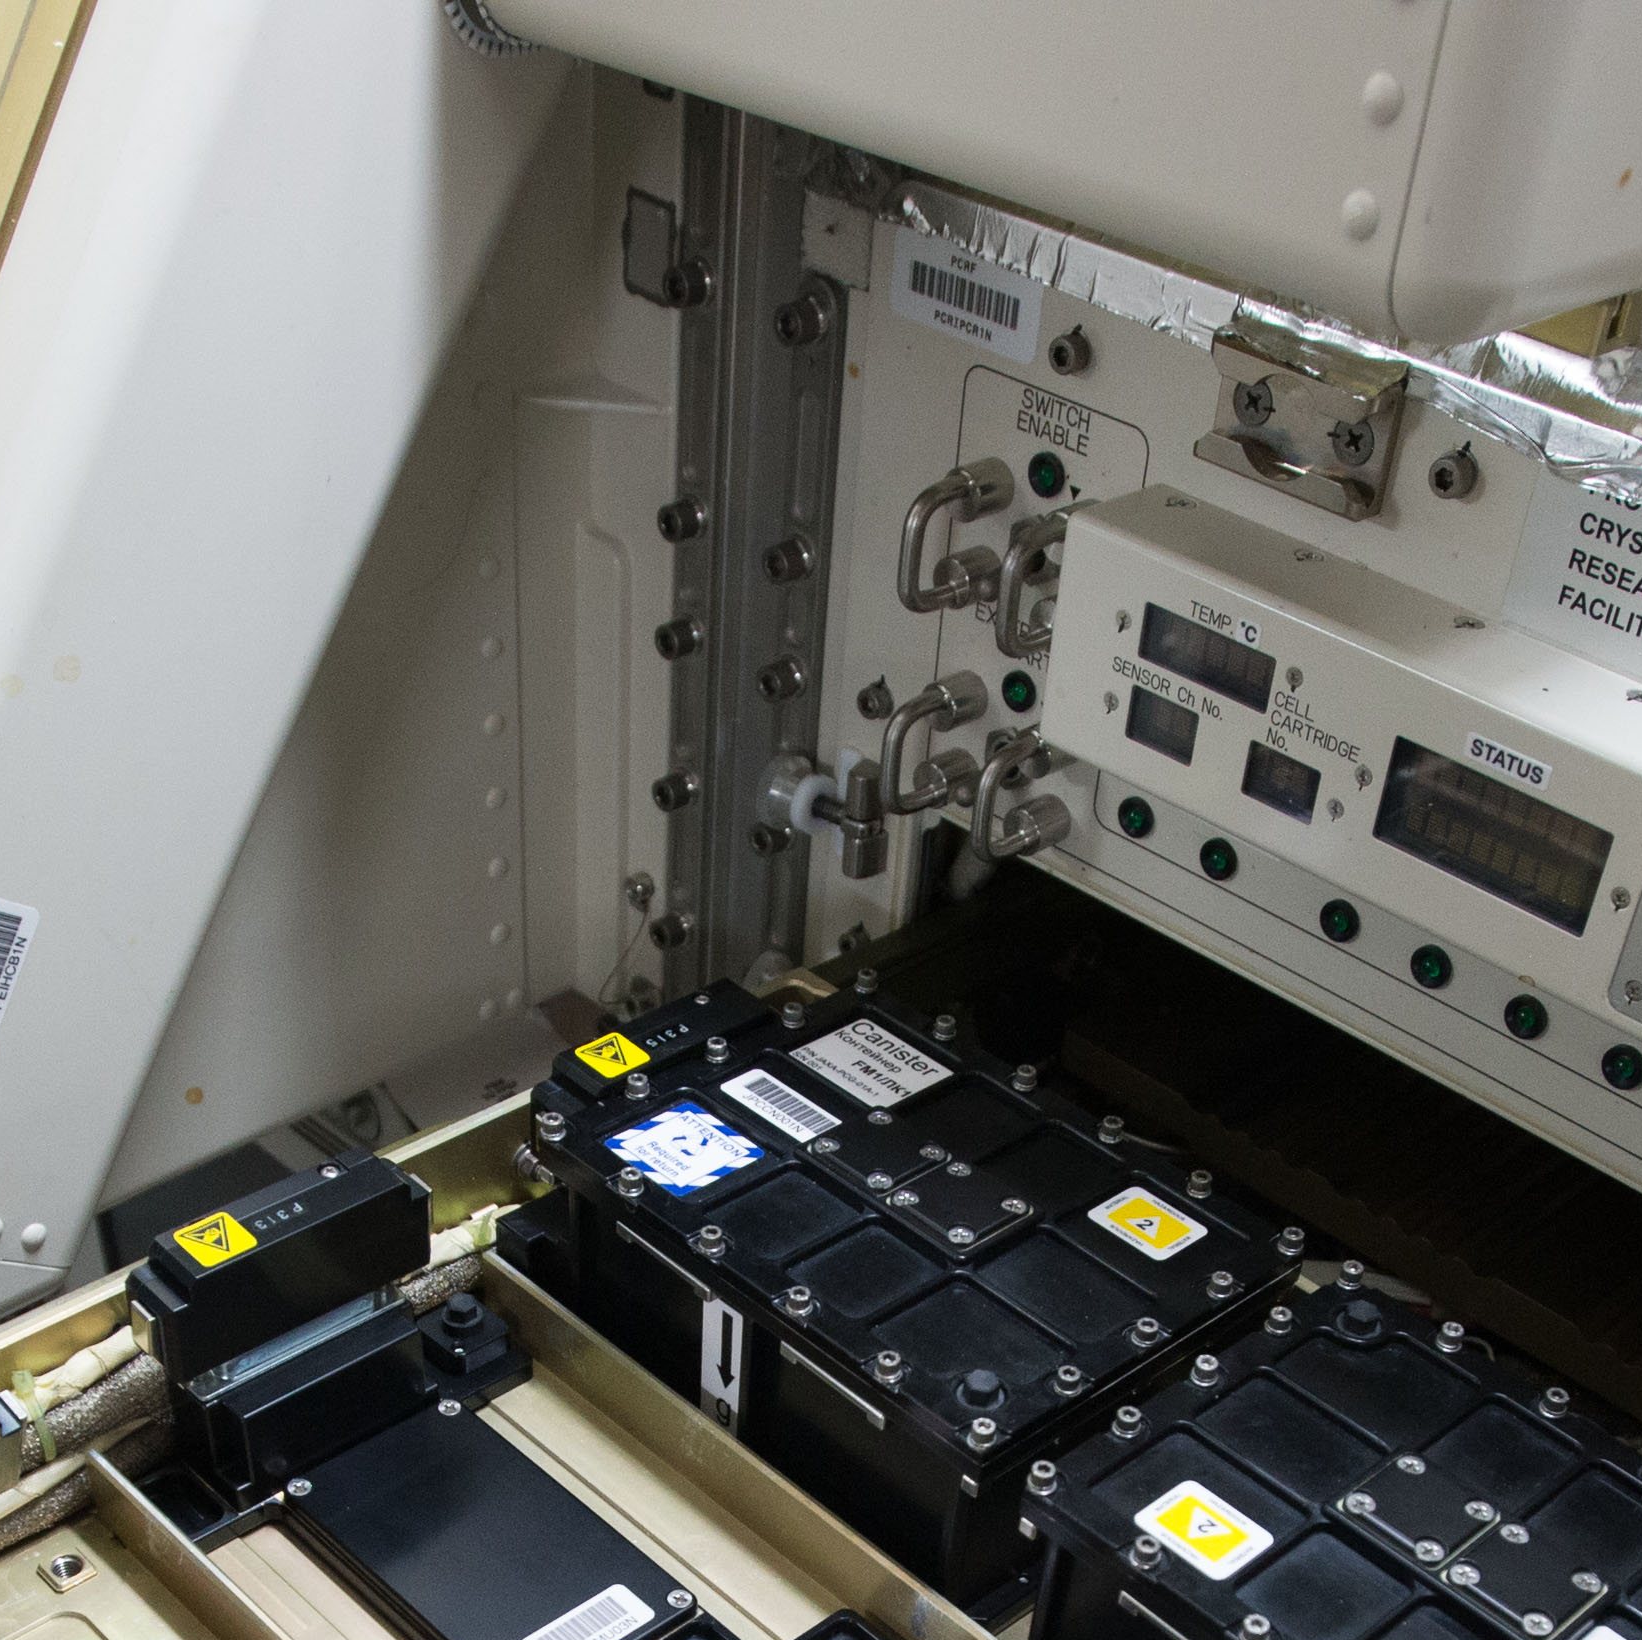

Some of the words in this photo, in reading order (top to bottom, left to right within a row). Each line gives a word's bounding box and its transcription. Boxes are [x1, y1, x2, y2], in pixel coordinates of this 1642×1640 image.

[1021, 388, 1092, 434] SWITCH
[1017, 410, 1090, 457] ENABLE
[1190, 600, 1233, 635] TEMP.
[1112, 656, 1171, 696] SENSOR
[1177, 687, 1196, 708] Ch
[1201, 697, 1223, 721] No.
[1274, 691, 1314, 722] CELL
[1266, 727, 1288, 752] No.
[1271, 709, 1361, 764] CARTRIDGE
[1470, 739, 1544, 785] STATUS
[645, 1023, 690, 1048] P315
[834, 1029, 901, 1074] Контейнер
[851, 1022, 938, 1076] Canister
[681, 1114, 742, 1158] ATTENTION
[636, 1145, 651, 1159] for
[651, 1156, 680, 1178] return
[646, 1140, 692, 1172] Required
[254, 1201, 304, 1230] P313
[1136, 1219, 1154, 1231] 2
[716, 1398, 730, 1427] g
[1198, 1520, 1217, 1533] 2
